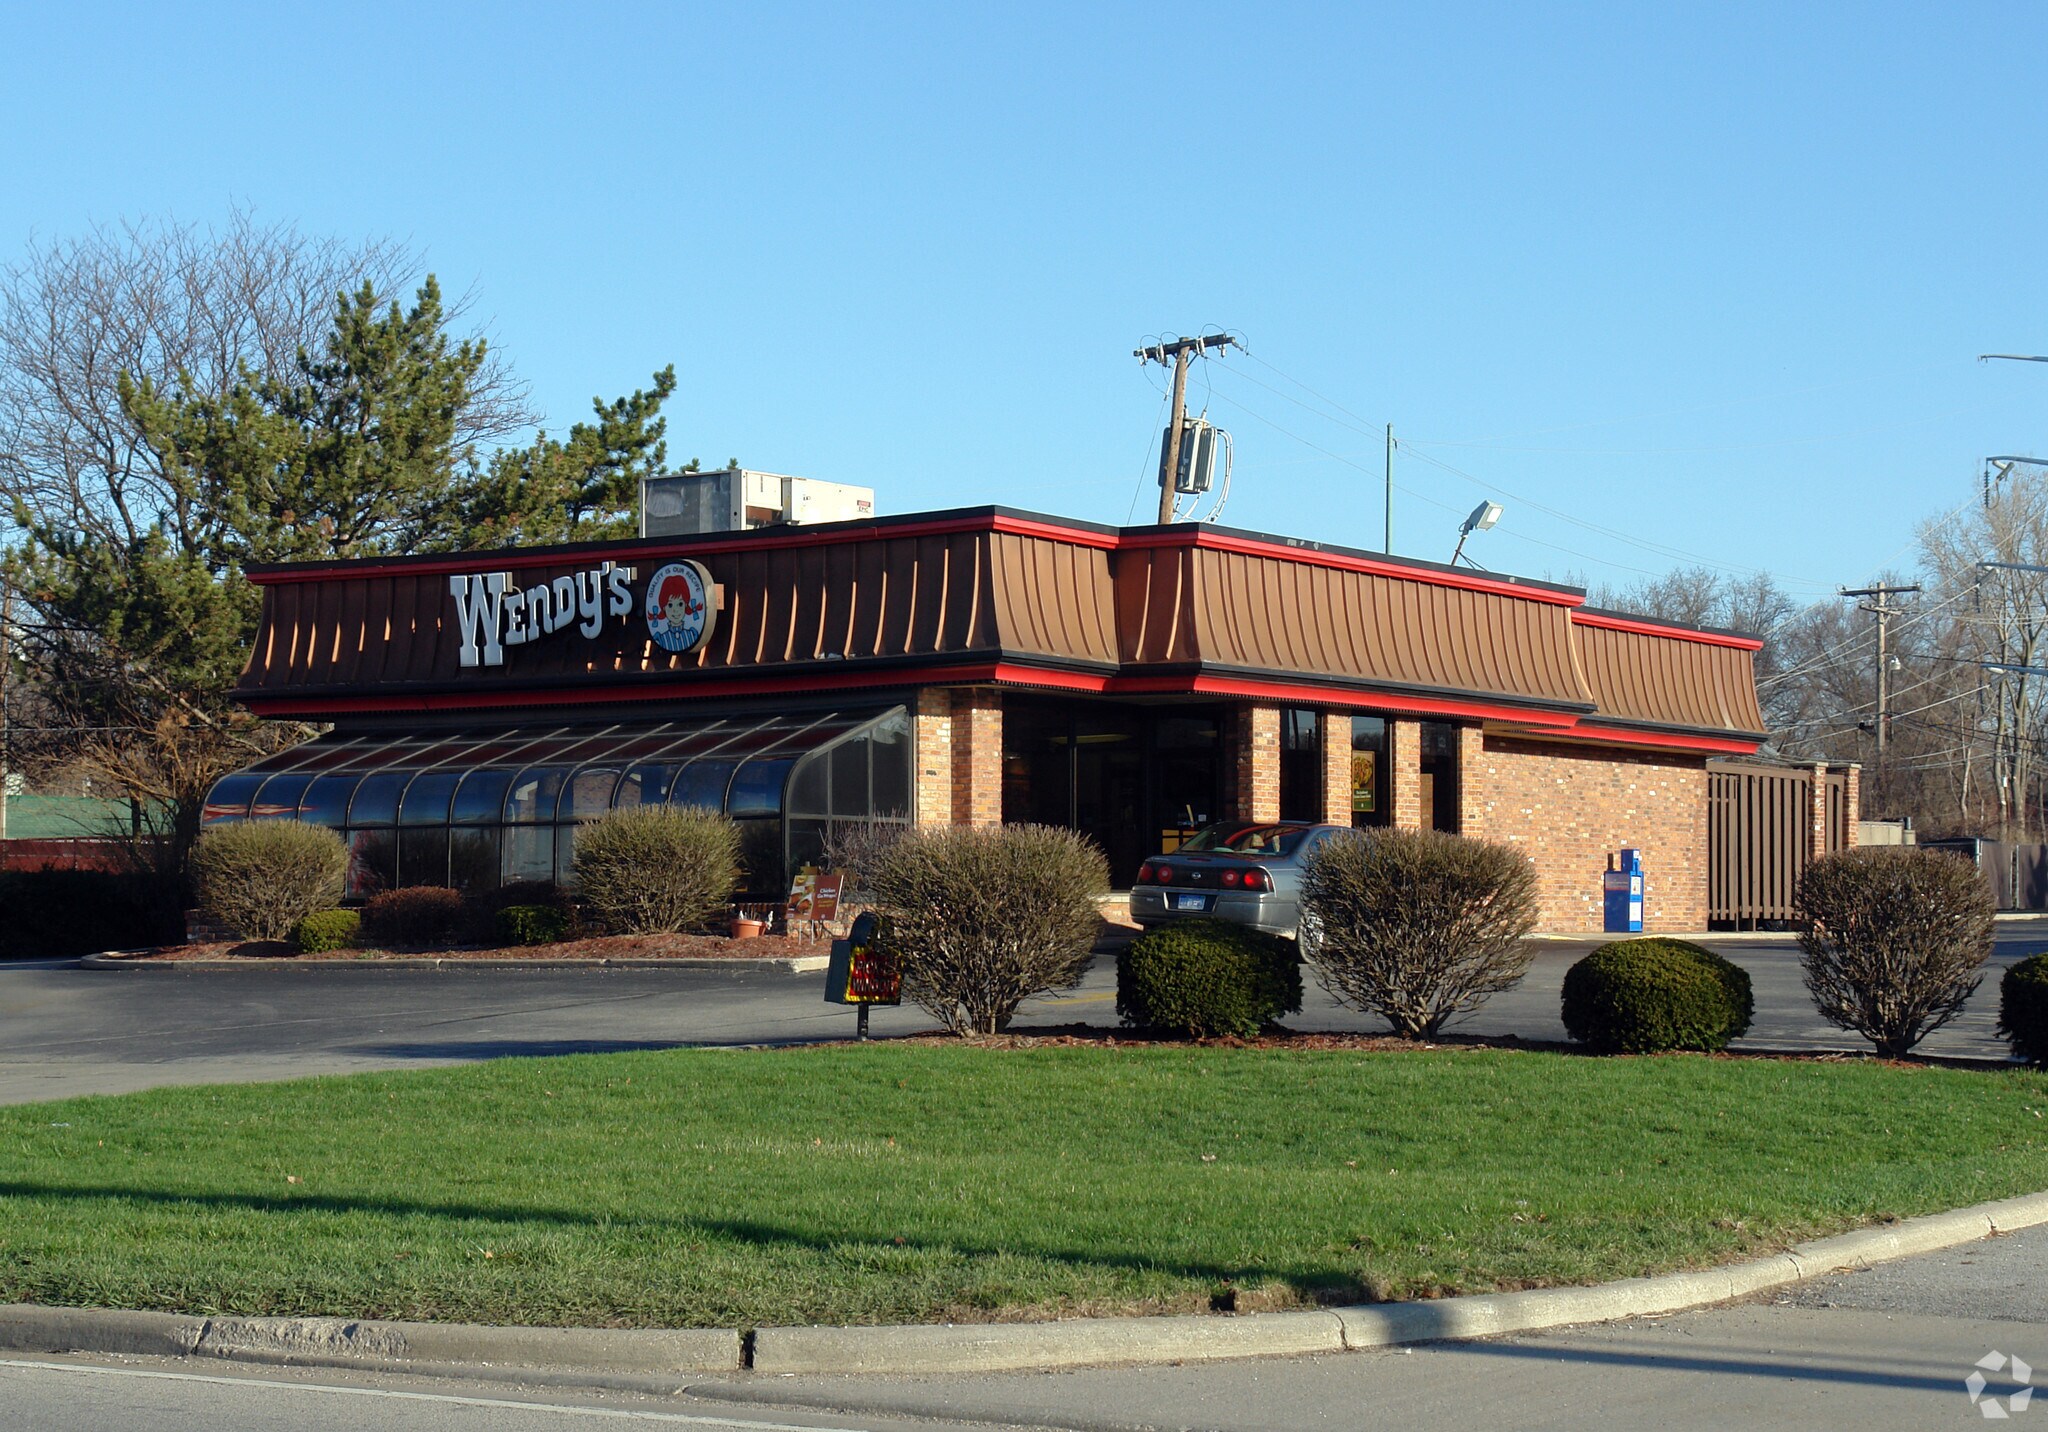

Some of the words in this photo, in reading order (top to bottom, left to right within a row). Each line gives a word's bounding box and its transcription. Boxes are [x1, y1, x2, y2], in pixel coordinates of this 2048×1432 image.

[648, 571, 664, 599] QUALITY
[672, 566, 685, 574] OUR
[686, 571, 701, 593] RECIPE
